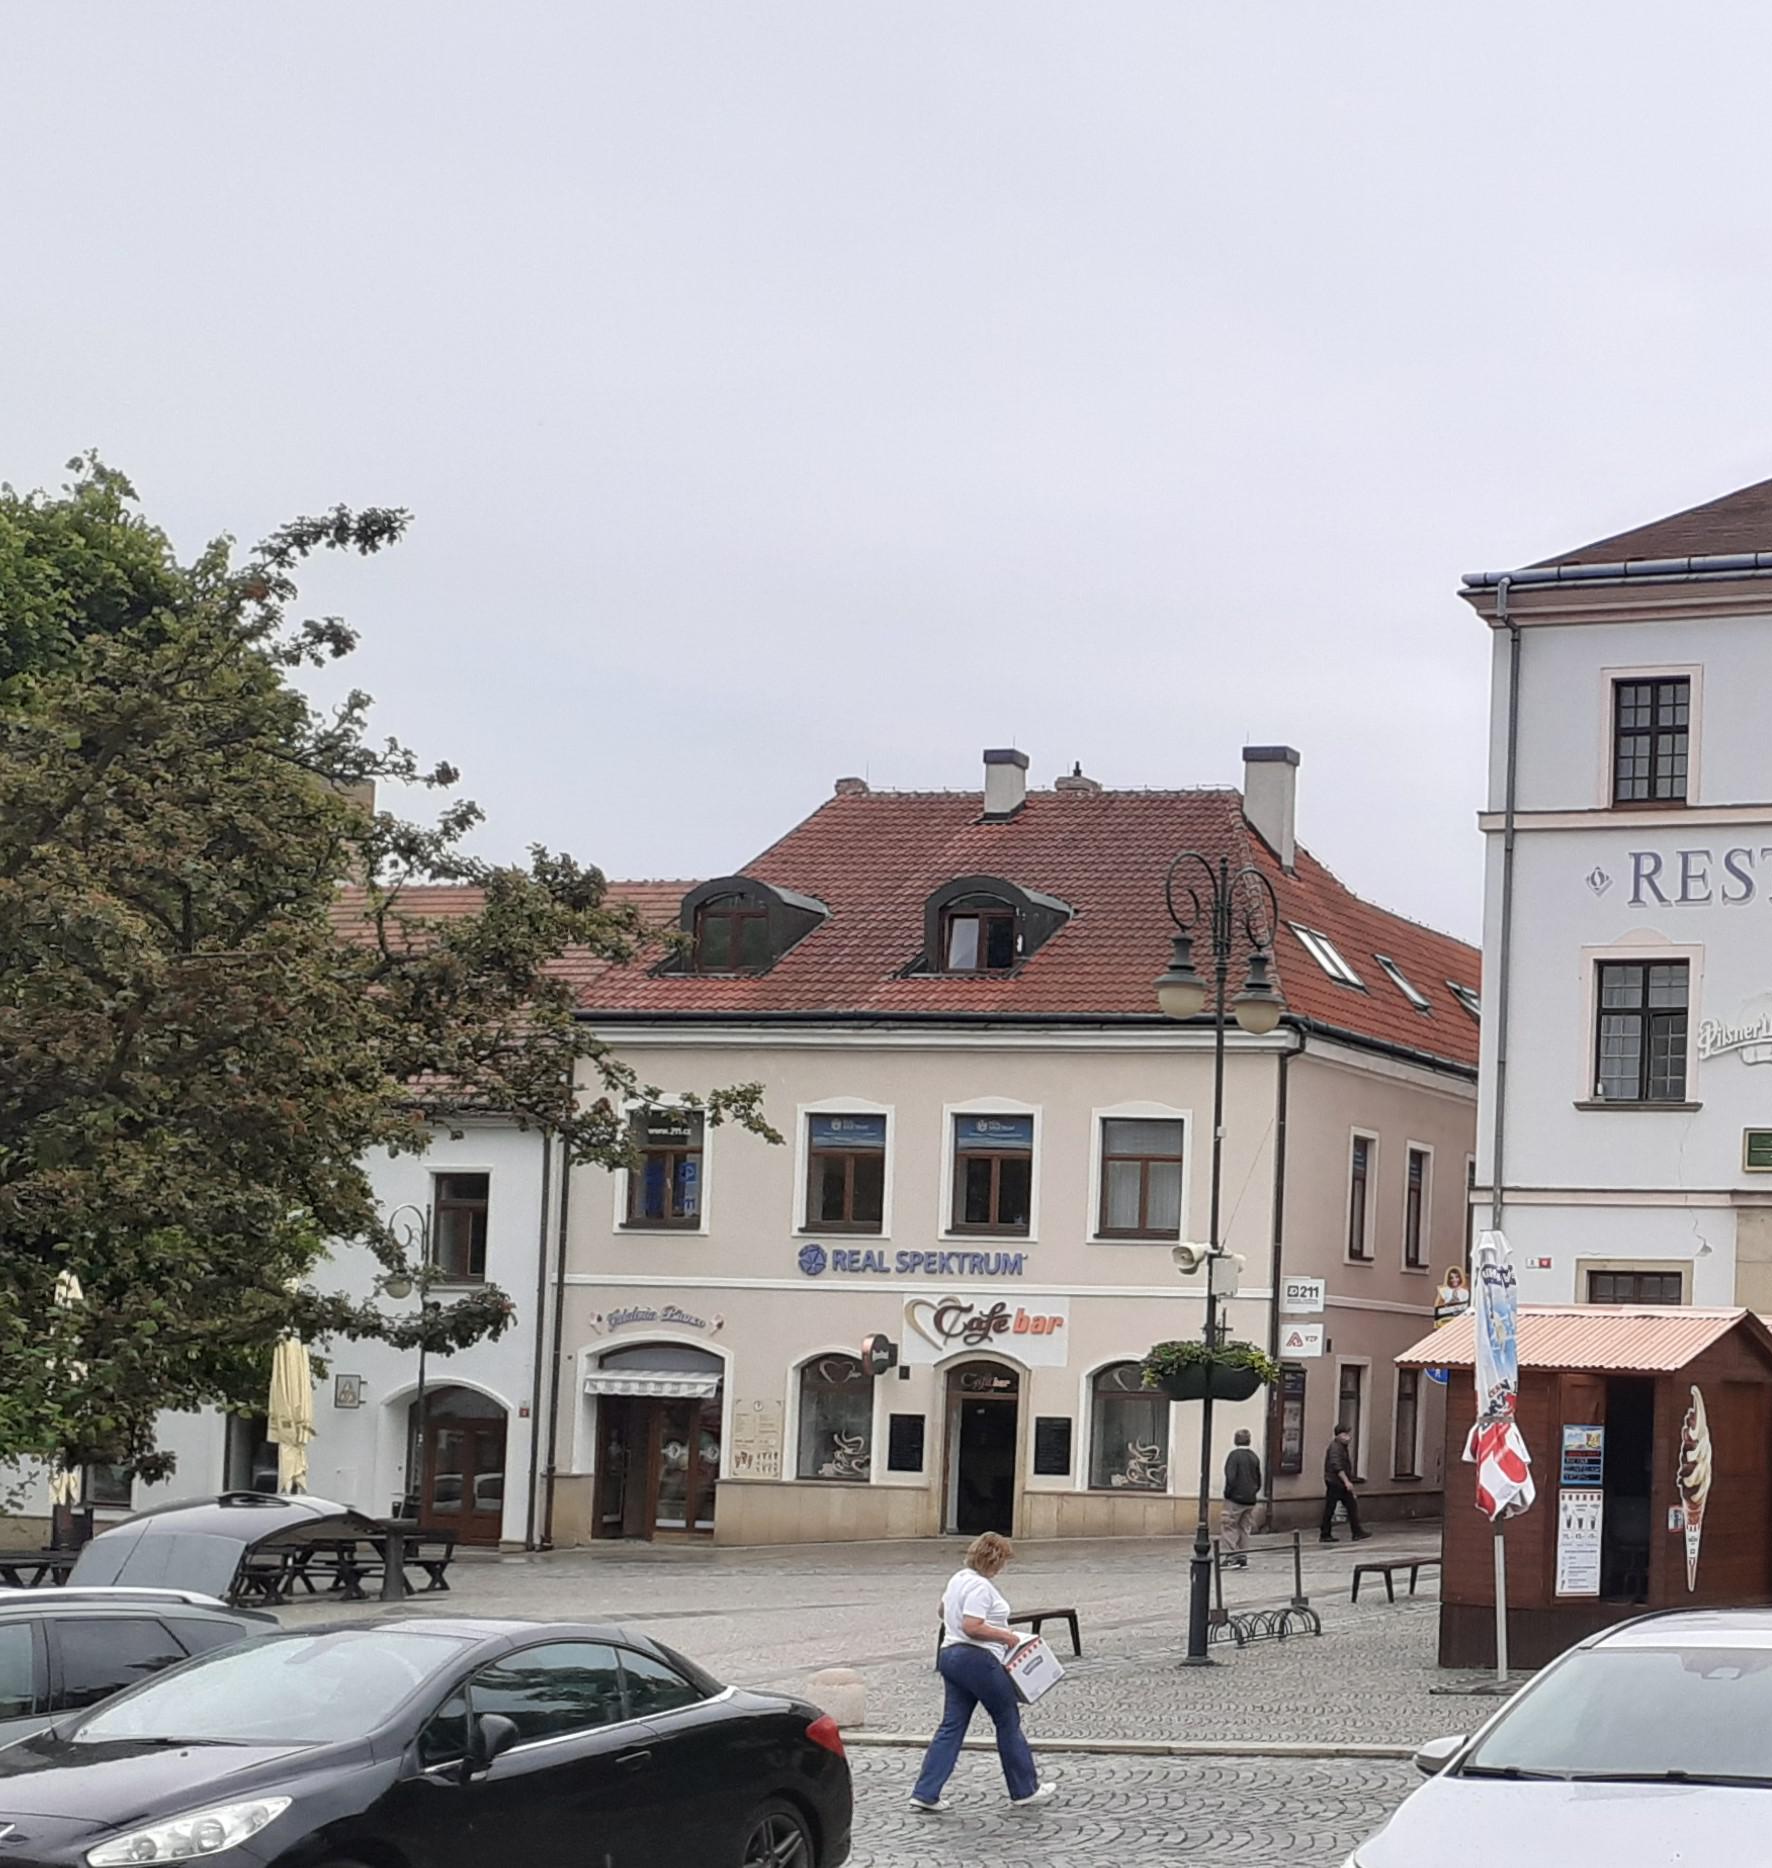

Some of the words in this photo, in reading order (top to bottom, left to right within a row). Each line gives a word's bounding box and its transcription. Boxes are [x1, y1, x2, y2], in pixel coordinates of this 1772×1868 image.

[832, 1249, 891, 1273] REAL
[895, 1250, 1023, 1276] SPEKTRUM
[1013, 1307, 1064, 1335] bar
